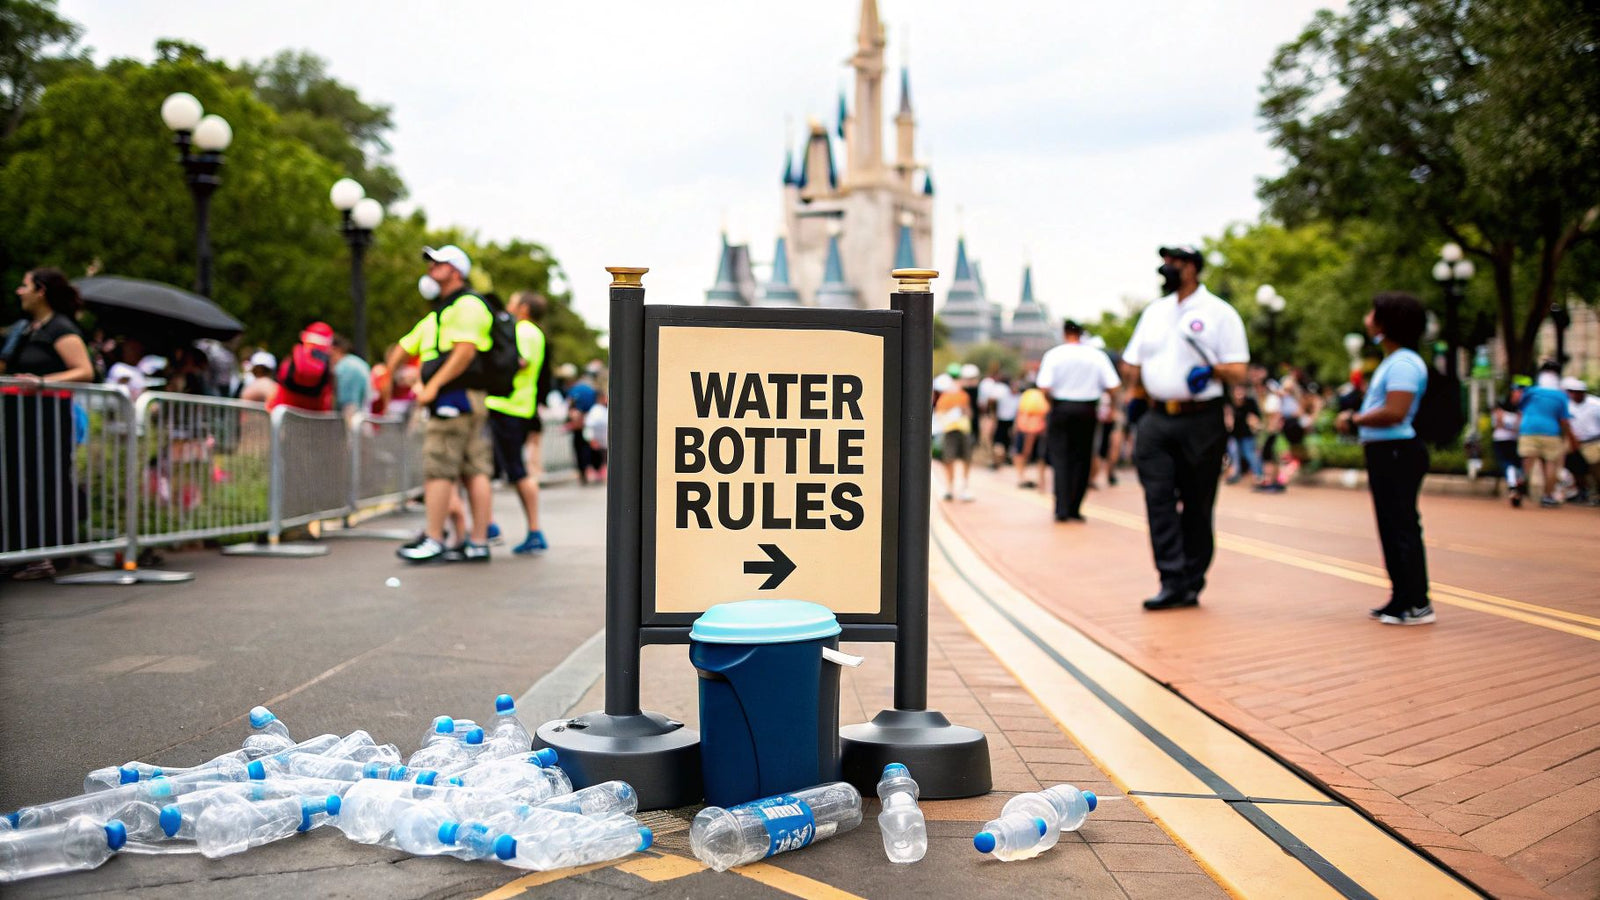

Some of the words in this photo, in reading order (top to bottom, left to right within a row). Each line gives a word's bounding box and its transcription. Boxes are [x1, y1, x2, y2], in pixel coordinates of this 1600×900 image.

[690, 372, 864, 420] WATER
[675, 426, 865, 475] BOTTLE
[675, 482, 865, 530] RULES
